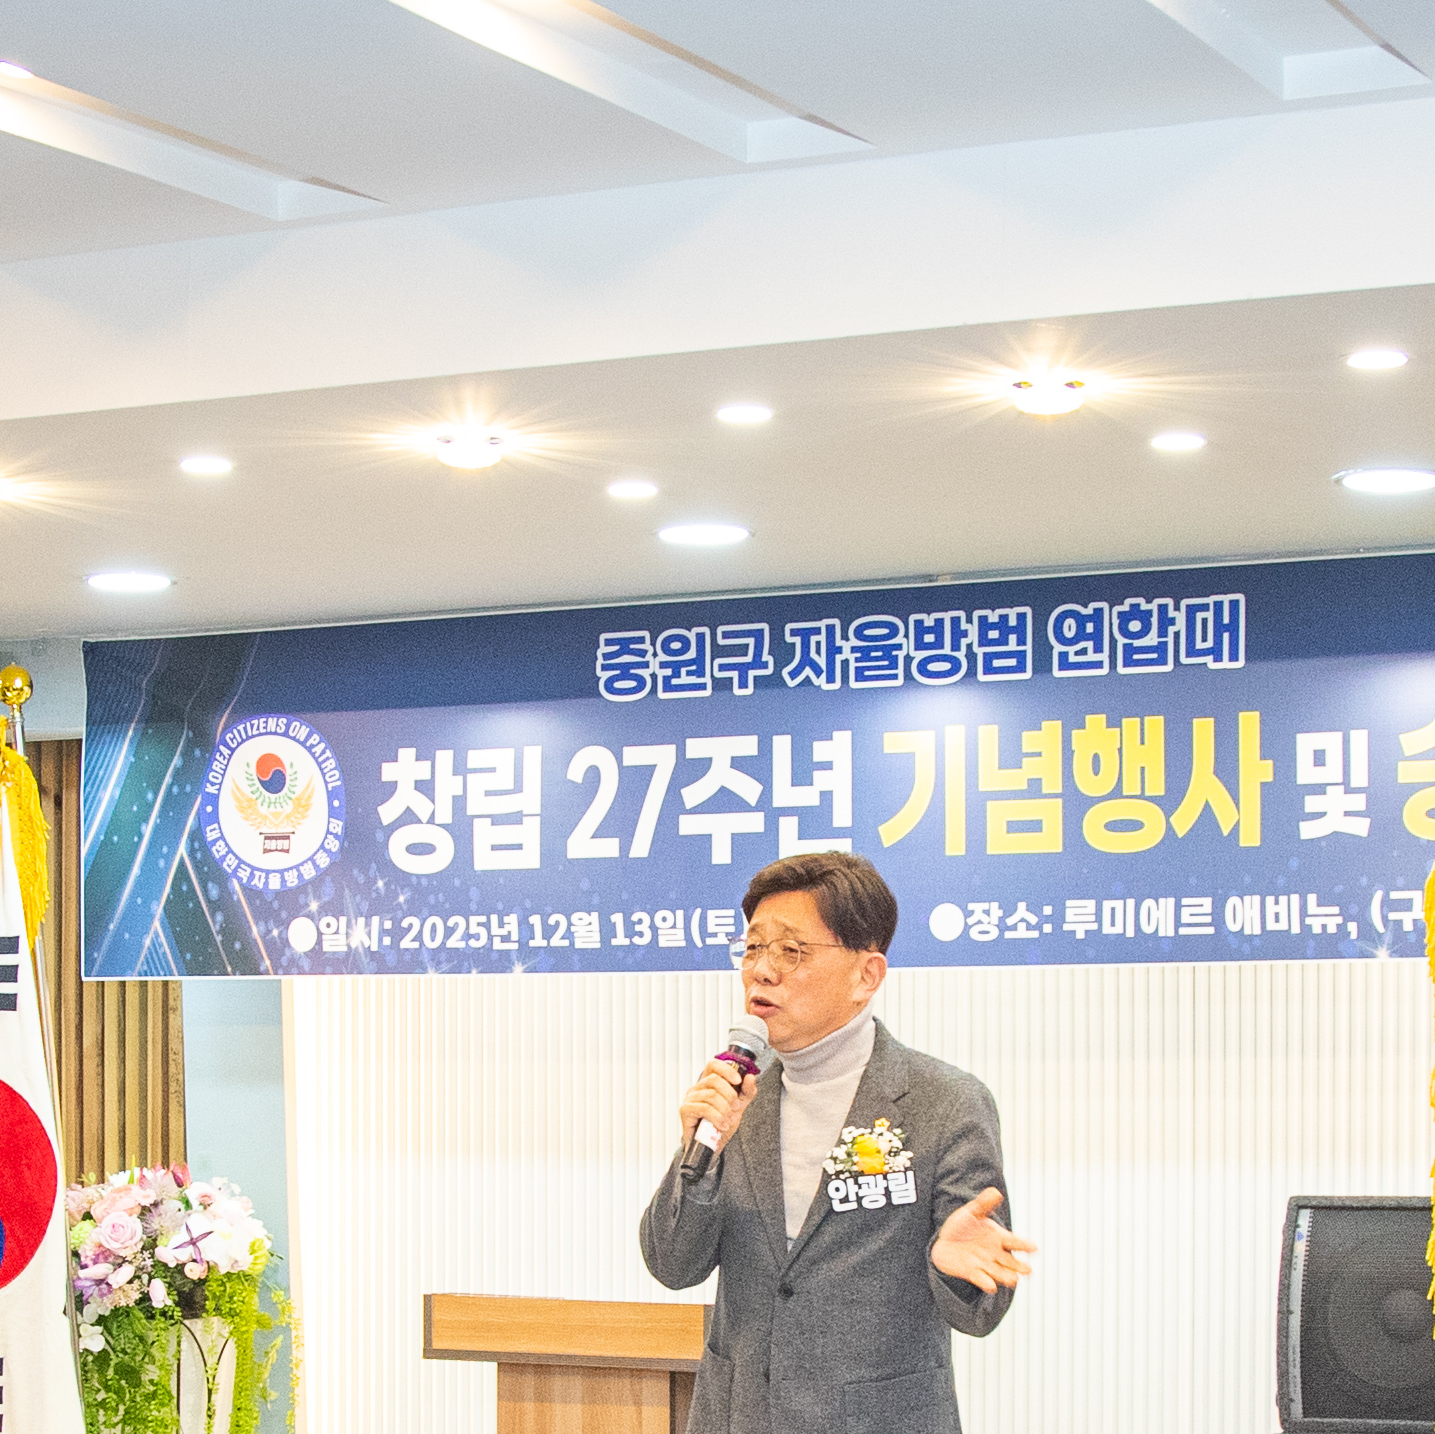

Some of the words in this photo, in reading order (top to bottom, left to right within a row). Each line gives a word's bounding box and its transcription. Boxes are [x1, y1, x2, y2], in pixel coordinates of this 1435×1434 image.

[597, 624, 774, 703] 중원구
[783, 607, 1033, 691] 자율방범
[1047, 593, 1246, 678] 연합대
[205, 745, 232, 794] KOREA
[225, 717, 288, 749] CITIZENS
[288, 721, 310, 742] ON
[306, 733, 342, 791] PATROL
[376, 743, 543, 875] 창립
[566, 730, 853, 864] 27주년
[878, 709, 1273, 856] 기념행사
[1294, 729, 1370, 841] 및
[319, 915, 391, 952] 일시:
[400, 915, 519, 949] 2025년
[528, 911, 602, 949] 12월
[966, 901, 1053, 941] 장소:
[1062, 897, 1215, 939] 루미에르
[1224, 893, 1358, 939] 애비뉴,
[827, 1170, 917, 1212] 안광림
